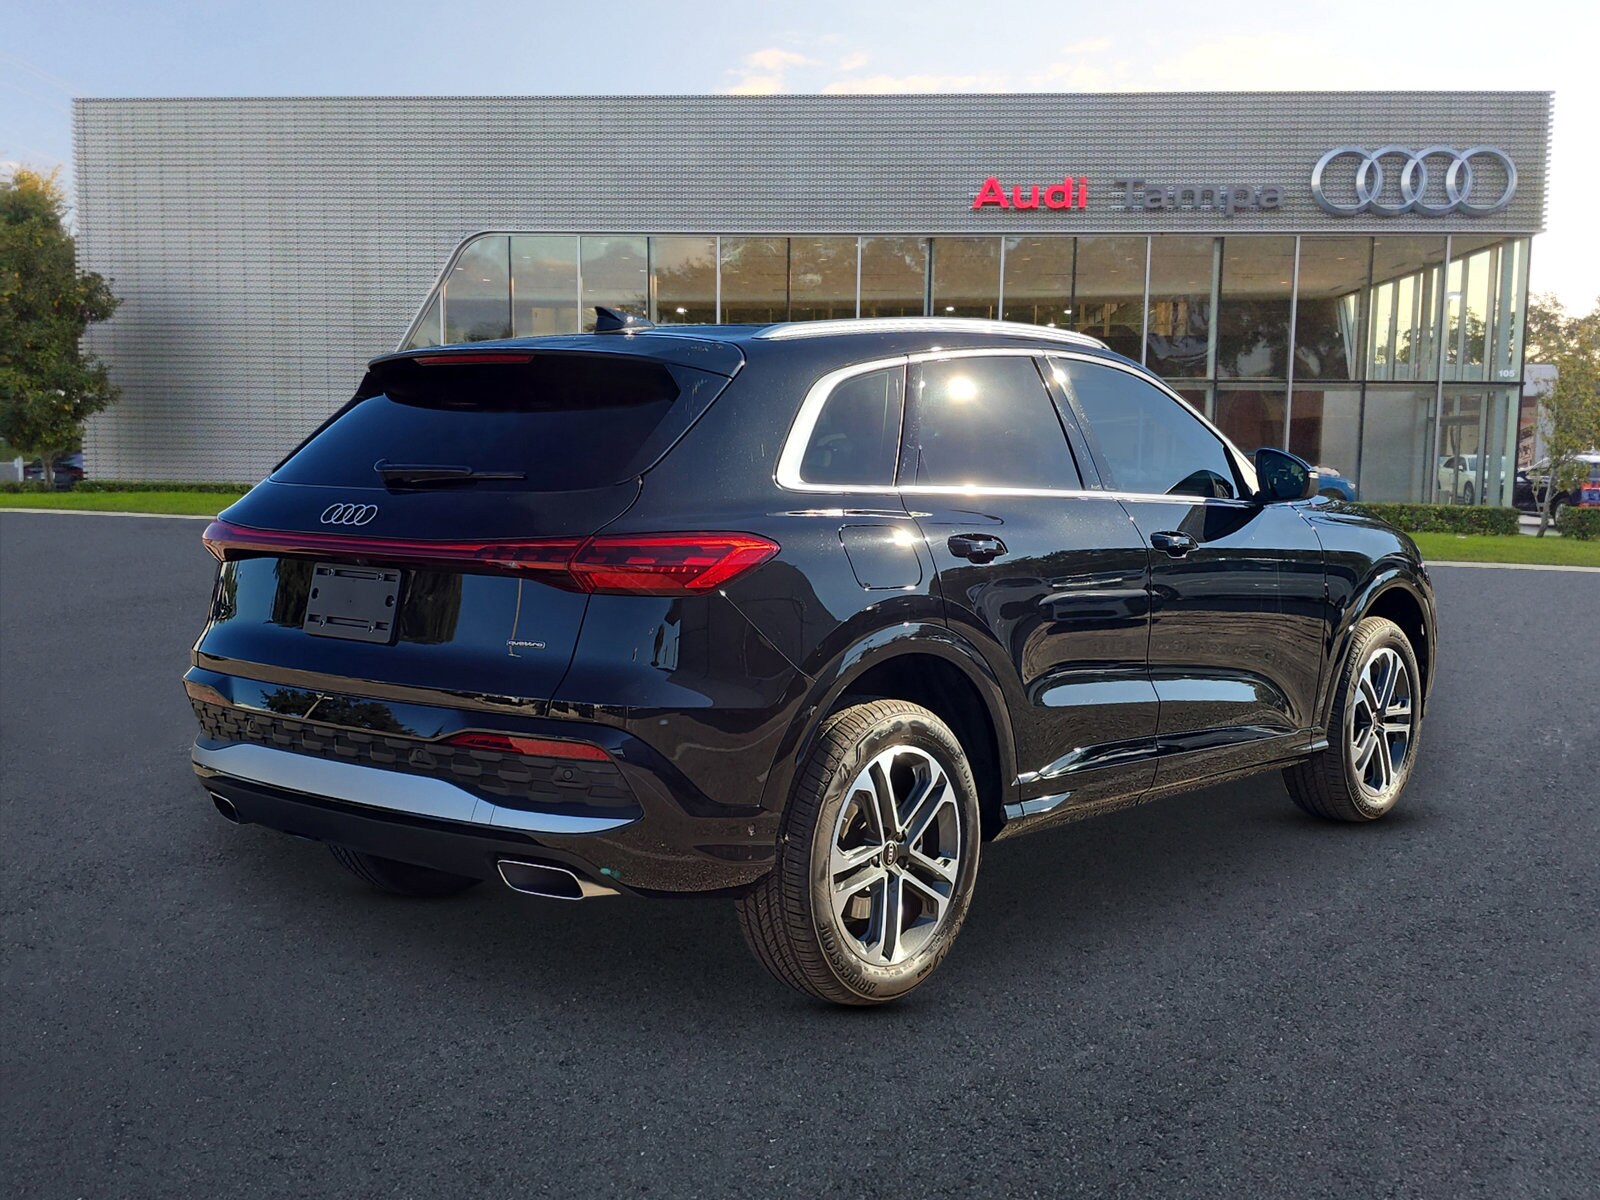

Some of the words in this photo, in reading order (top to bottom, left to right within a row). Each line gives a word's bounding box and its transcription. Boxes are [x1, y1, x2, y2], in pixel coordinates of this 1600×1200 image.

[972, 176, 1088, 210] Audi
[1115, 177, 1286, 217] Tampa
[1499, 369, 1515, 378] 105
[819, 921, 878, 996] BRIDGESTONE
